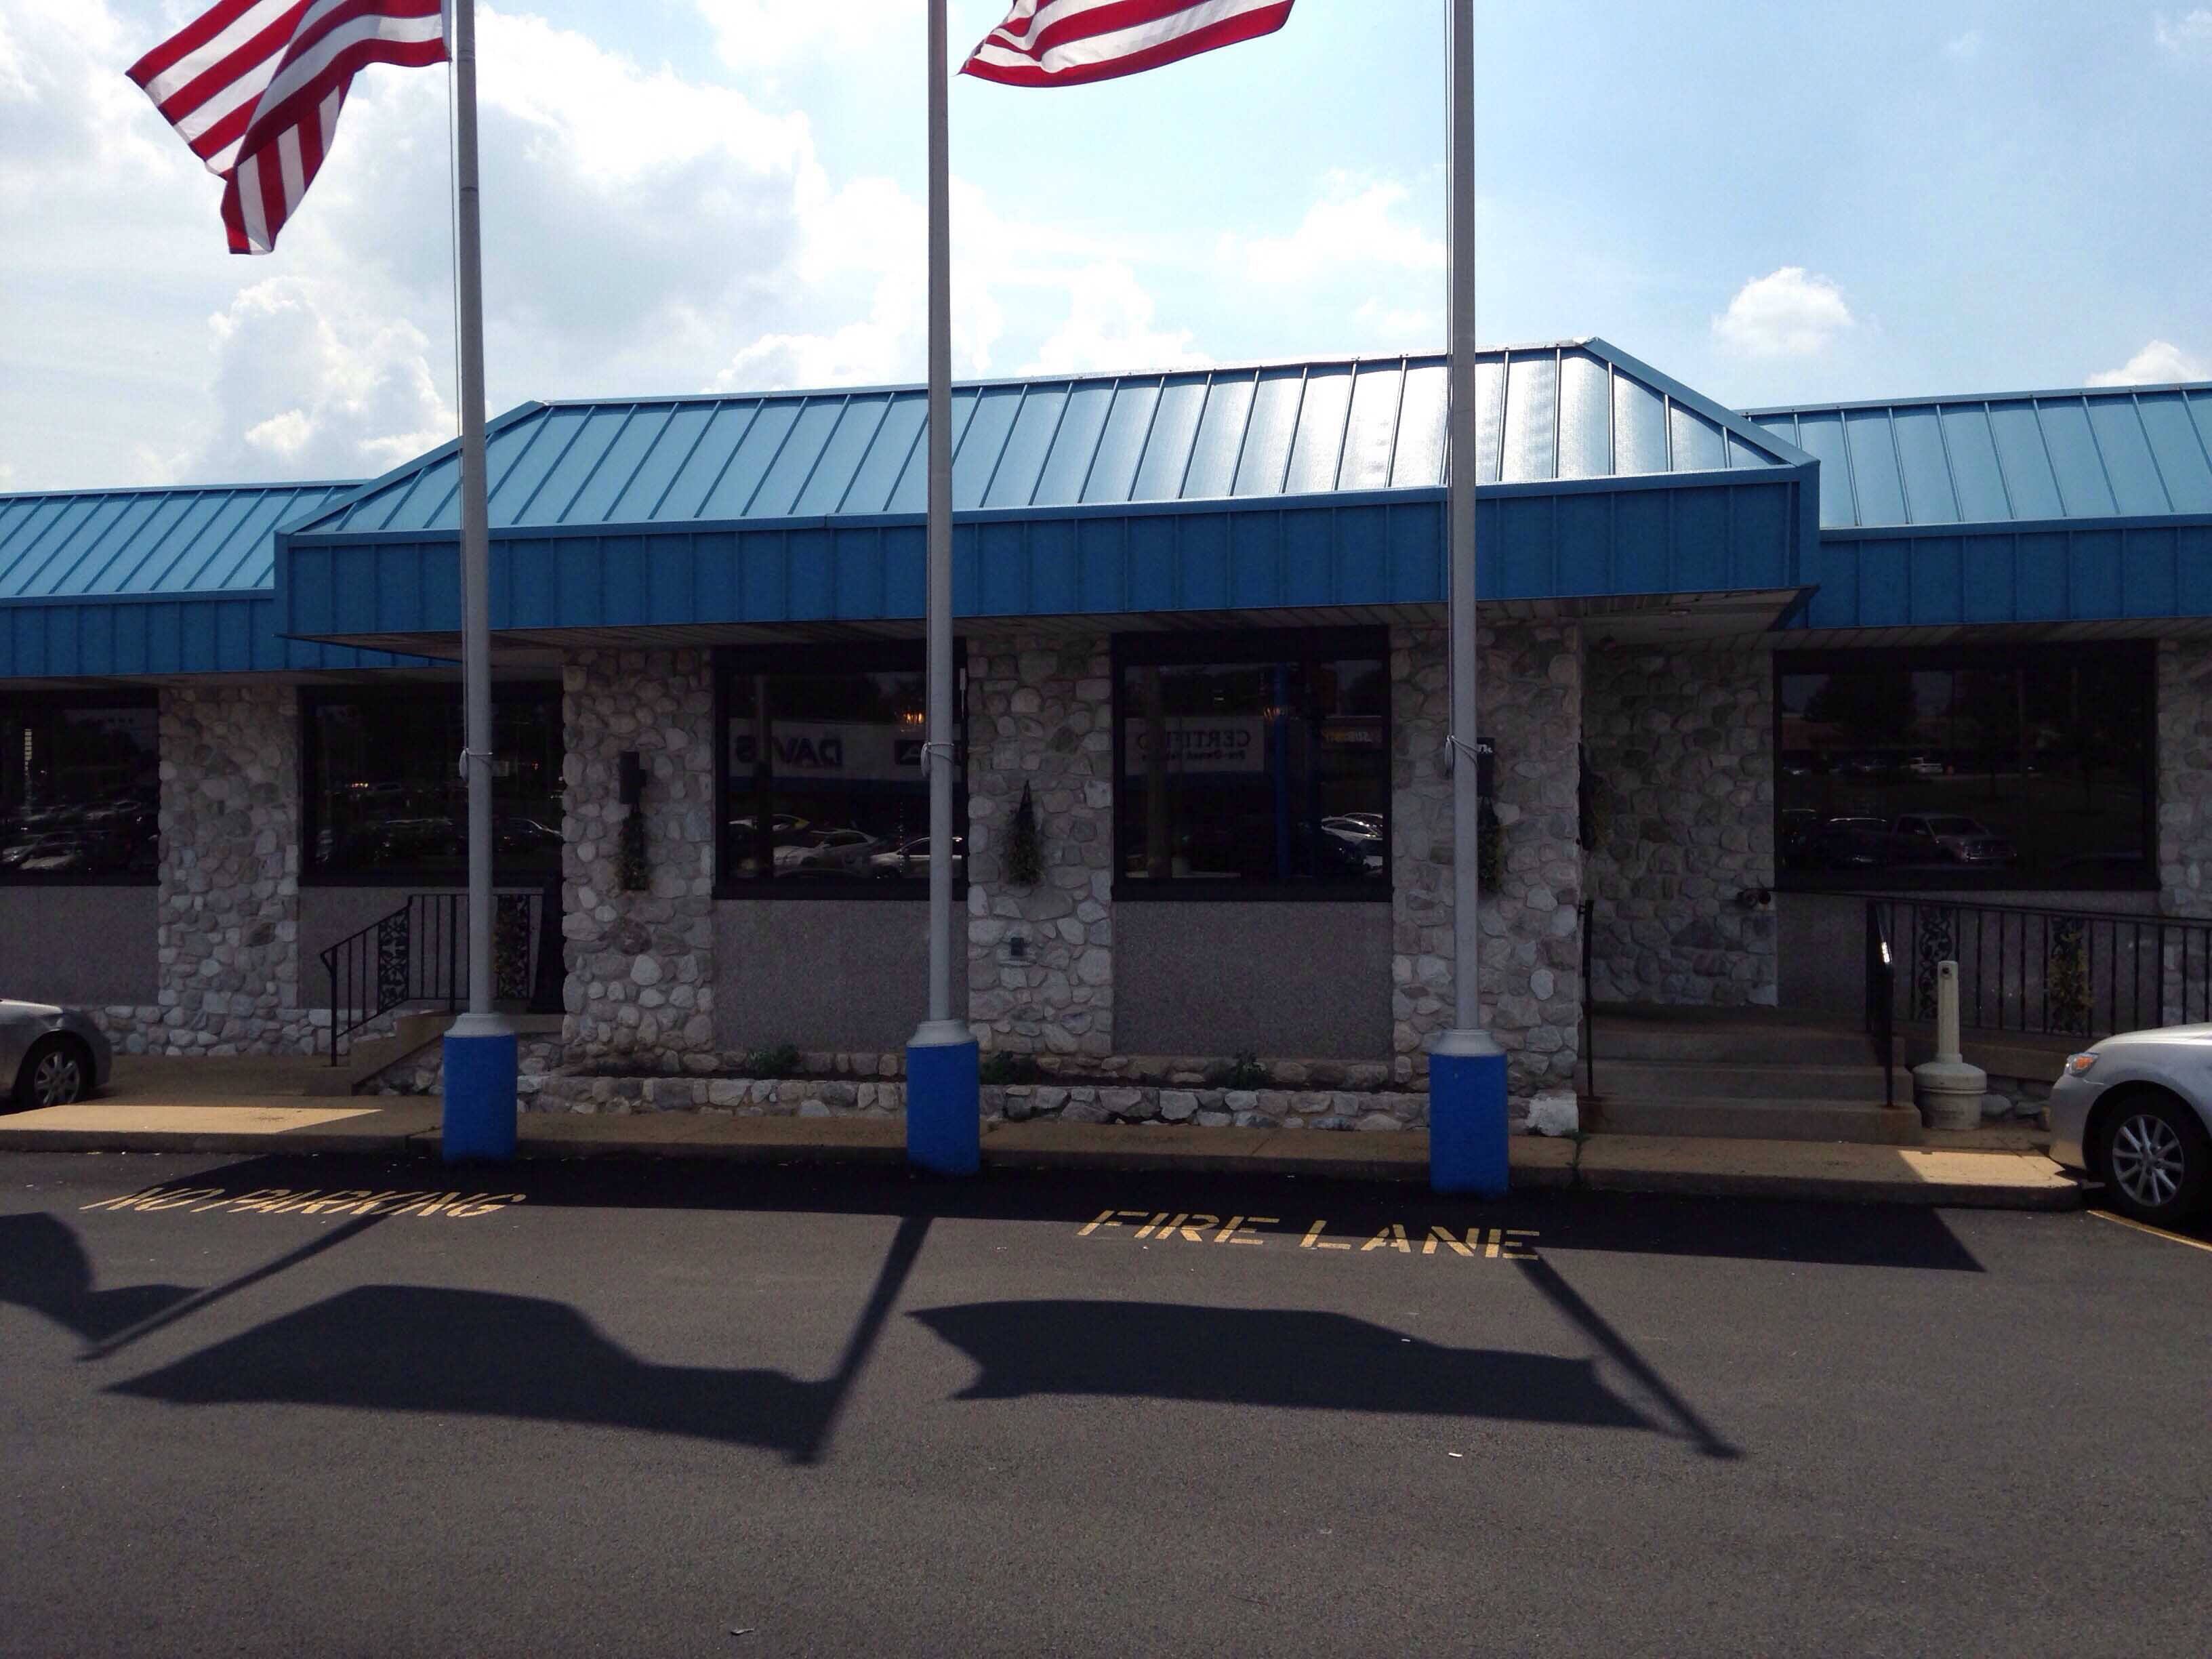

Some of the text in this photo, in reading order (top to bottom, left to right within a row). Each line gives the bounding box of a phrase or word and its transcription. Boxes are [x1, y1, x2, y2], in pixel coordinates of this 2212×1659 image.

[79, 1187, 527, 1217] NO PARKING
[1077, 1210, 1540, 1261] FIRE LANE
